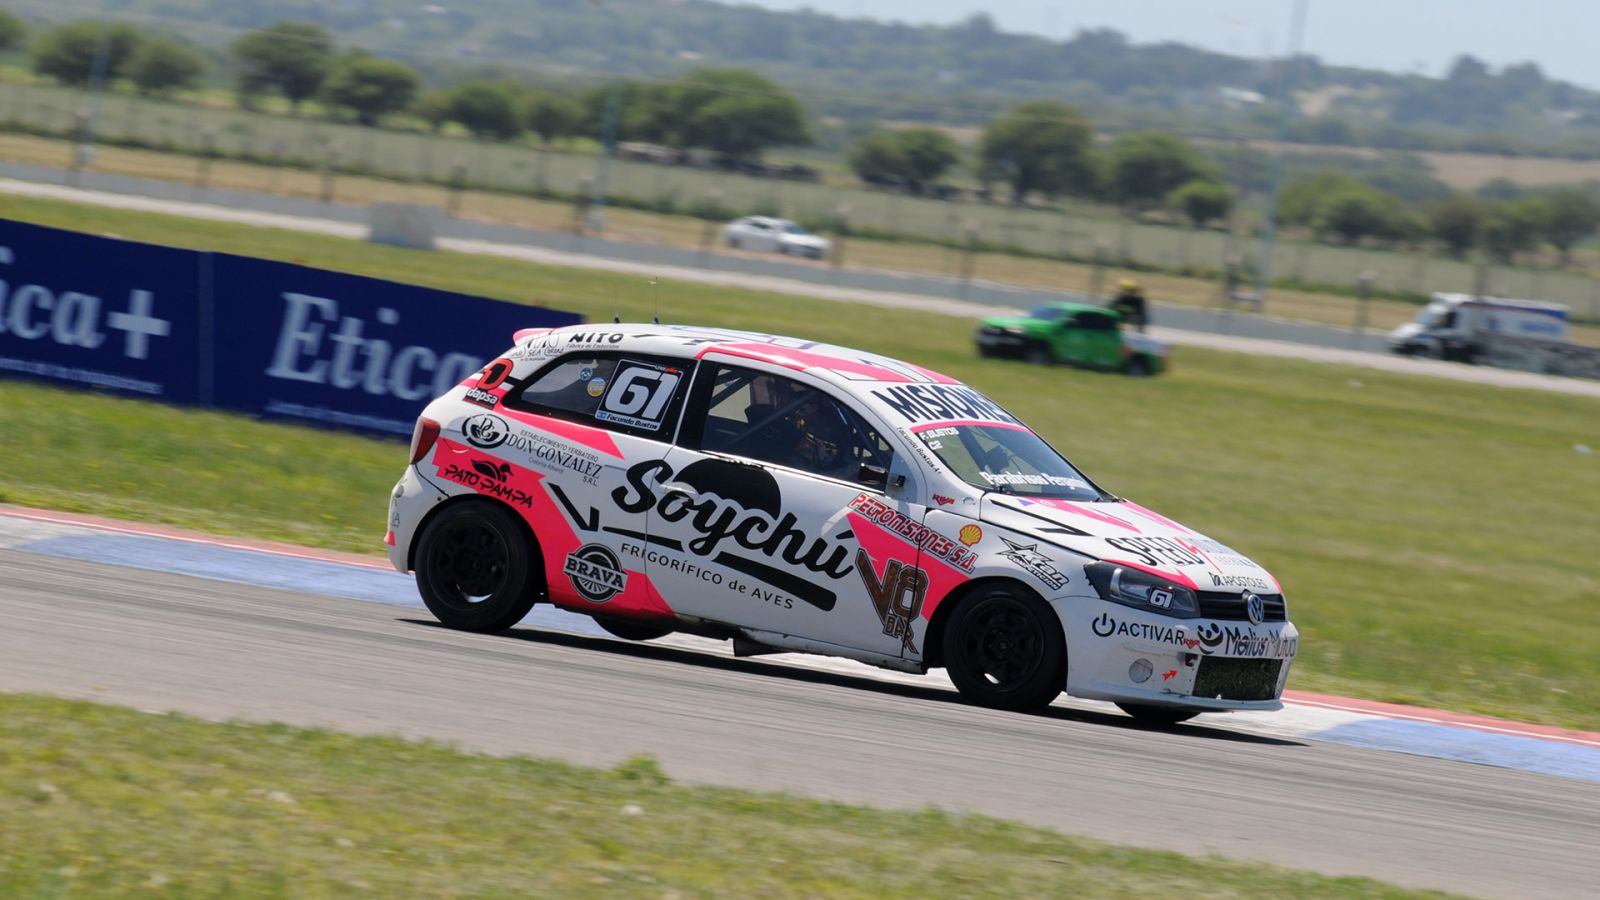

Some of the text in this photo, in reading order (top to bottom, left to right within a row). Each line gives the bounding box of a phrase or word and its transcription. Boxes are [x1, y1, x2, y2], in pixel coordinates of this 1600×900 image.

[568, 332, 625, 344] NITO
[466, 387, 499, 405] dapsa
[605, 366, 679, 420] 61
[606, 412, 659, 430] Facundo Bustos
[519, 429, 568, 451] ESTABLECIMIENTO
[506, 433, 603, 480] DON GONZALEZ
[916, 447, 935, 468] Bustos
[444, 464, 533, 509] PATO PAMPA
[611, 459, 856, 579] Soychú
[1104, 536, 1206, 567] SPEED
[564, 556, 625, 588] BRAVA
[620, 543, 794, 610] FRIGORÍFICO de AVES
[1224, 575, 1269, 590] APOSTOLES
[855, 547, 929, 630] V8
[1149, 588, 1174, 609] 61
[1116, 622, 1185, 647] ACTIVAR
